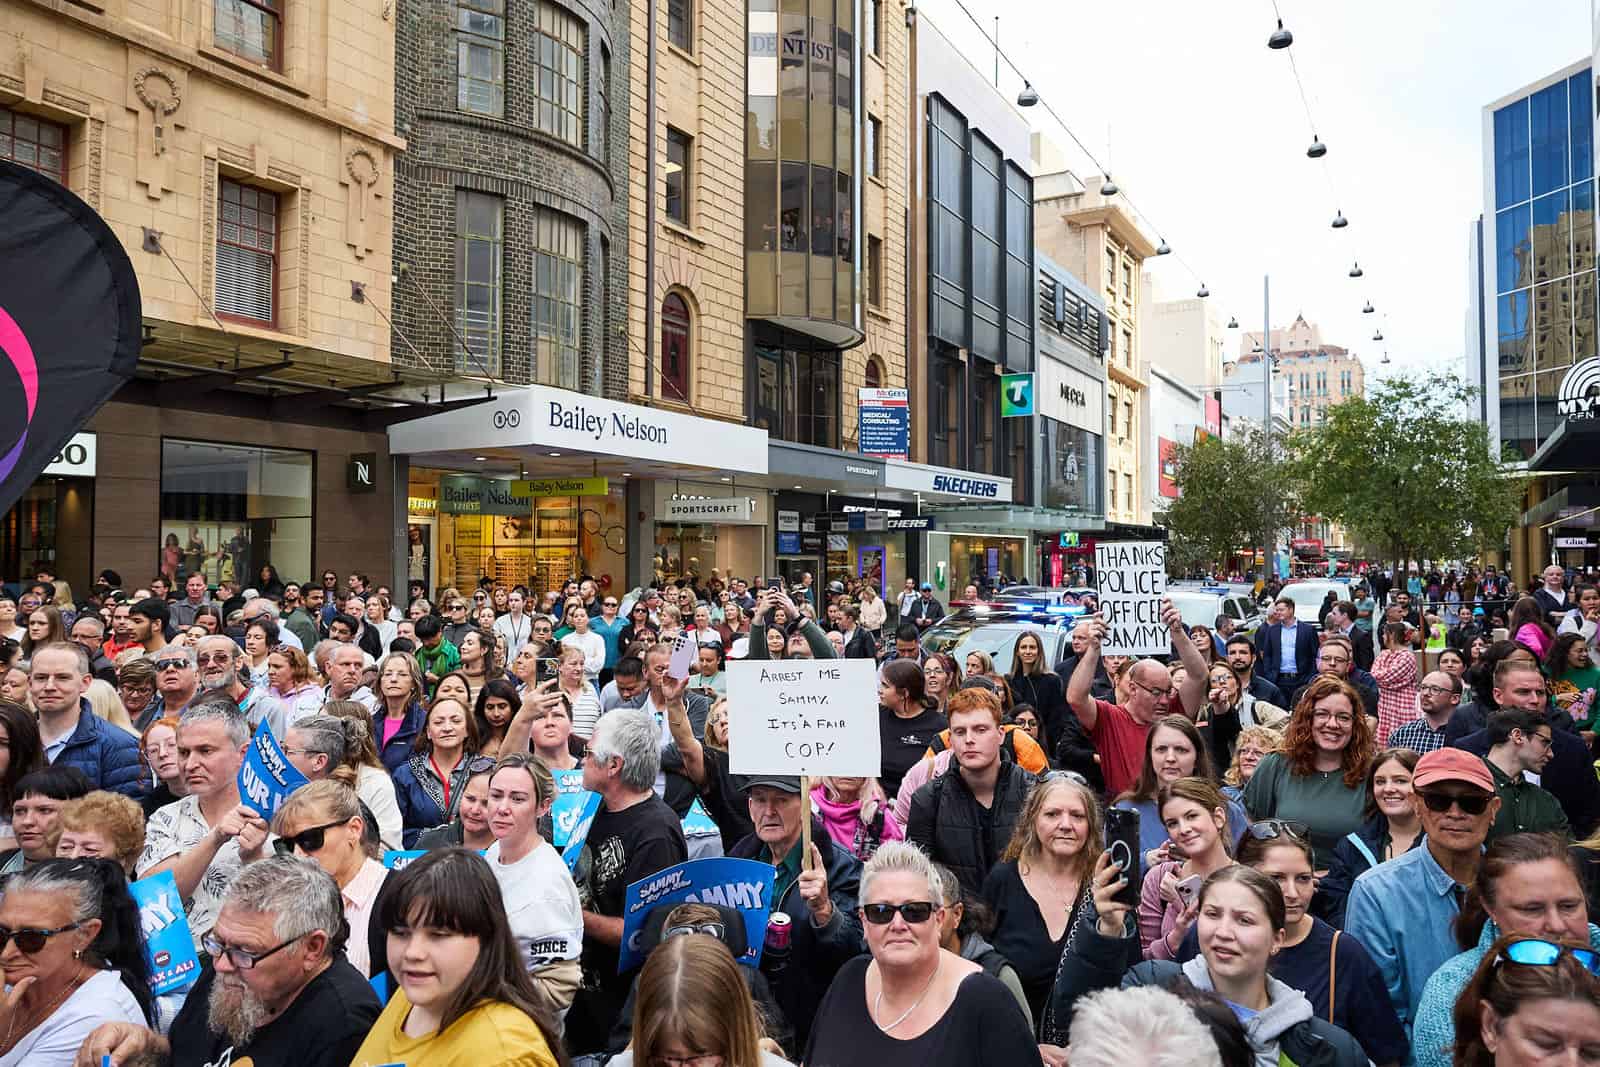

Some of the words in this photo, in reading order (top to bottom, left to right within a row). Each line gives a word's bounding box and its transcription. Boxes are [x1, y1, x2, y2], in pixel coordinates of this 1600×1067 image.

[751, 36, 833, 61] DENTIST
[1060, 382, 1086, 407] MECCA
[550, 401, 607, 440] Bailey
[612, 412, 667, 444] Nelson
[932, 475, 998, 497] SKECHERS
[671, 505, 737, 514] SPORTSCRAFT
[888, 519, 928, 528] CHERS
[1096, 545, 1163, 568] THANKS
[1098, 570, 1162, 594] POLICE
[1103, 625, 1170, 648] SAMMY
[760, 668, 803, 683] ARREST
[819, 669, 841, 680] ME
[803, 719, 812, 729] A
[817, 719, 847, 729] FAIR
[785, 742, 835, 758] COP!
[243, 761, 270, 810] OUR
[640, 870, 684, 898] SAMMY
[530, 940, 568, 955] SINCE
[147, 971, 166, 985] AX
[175, 959, 194, 975] ALI
